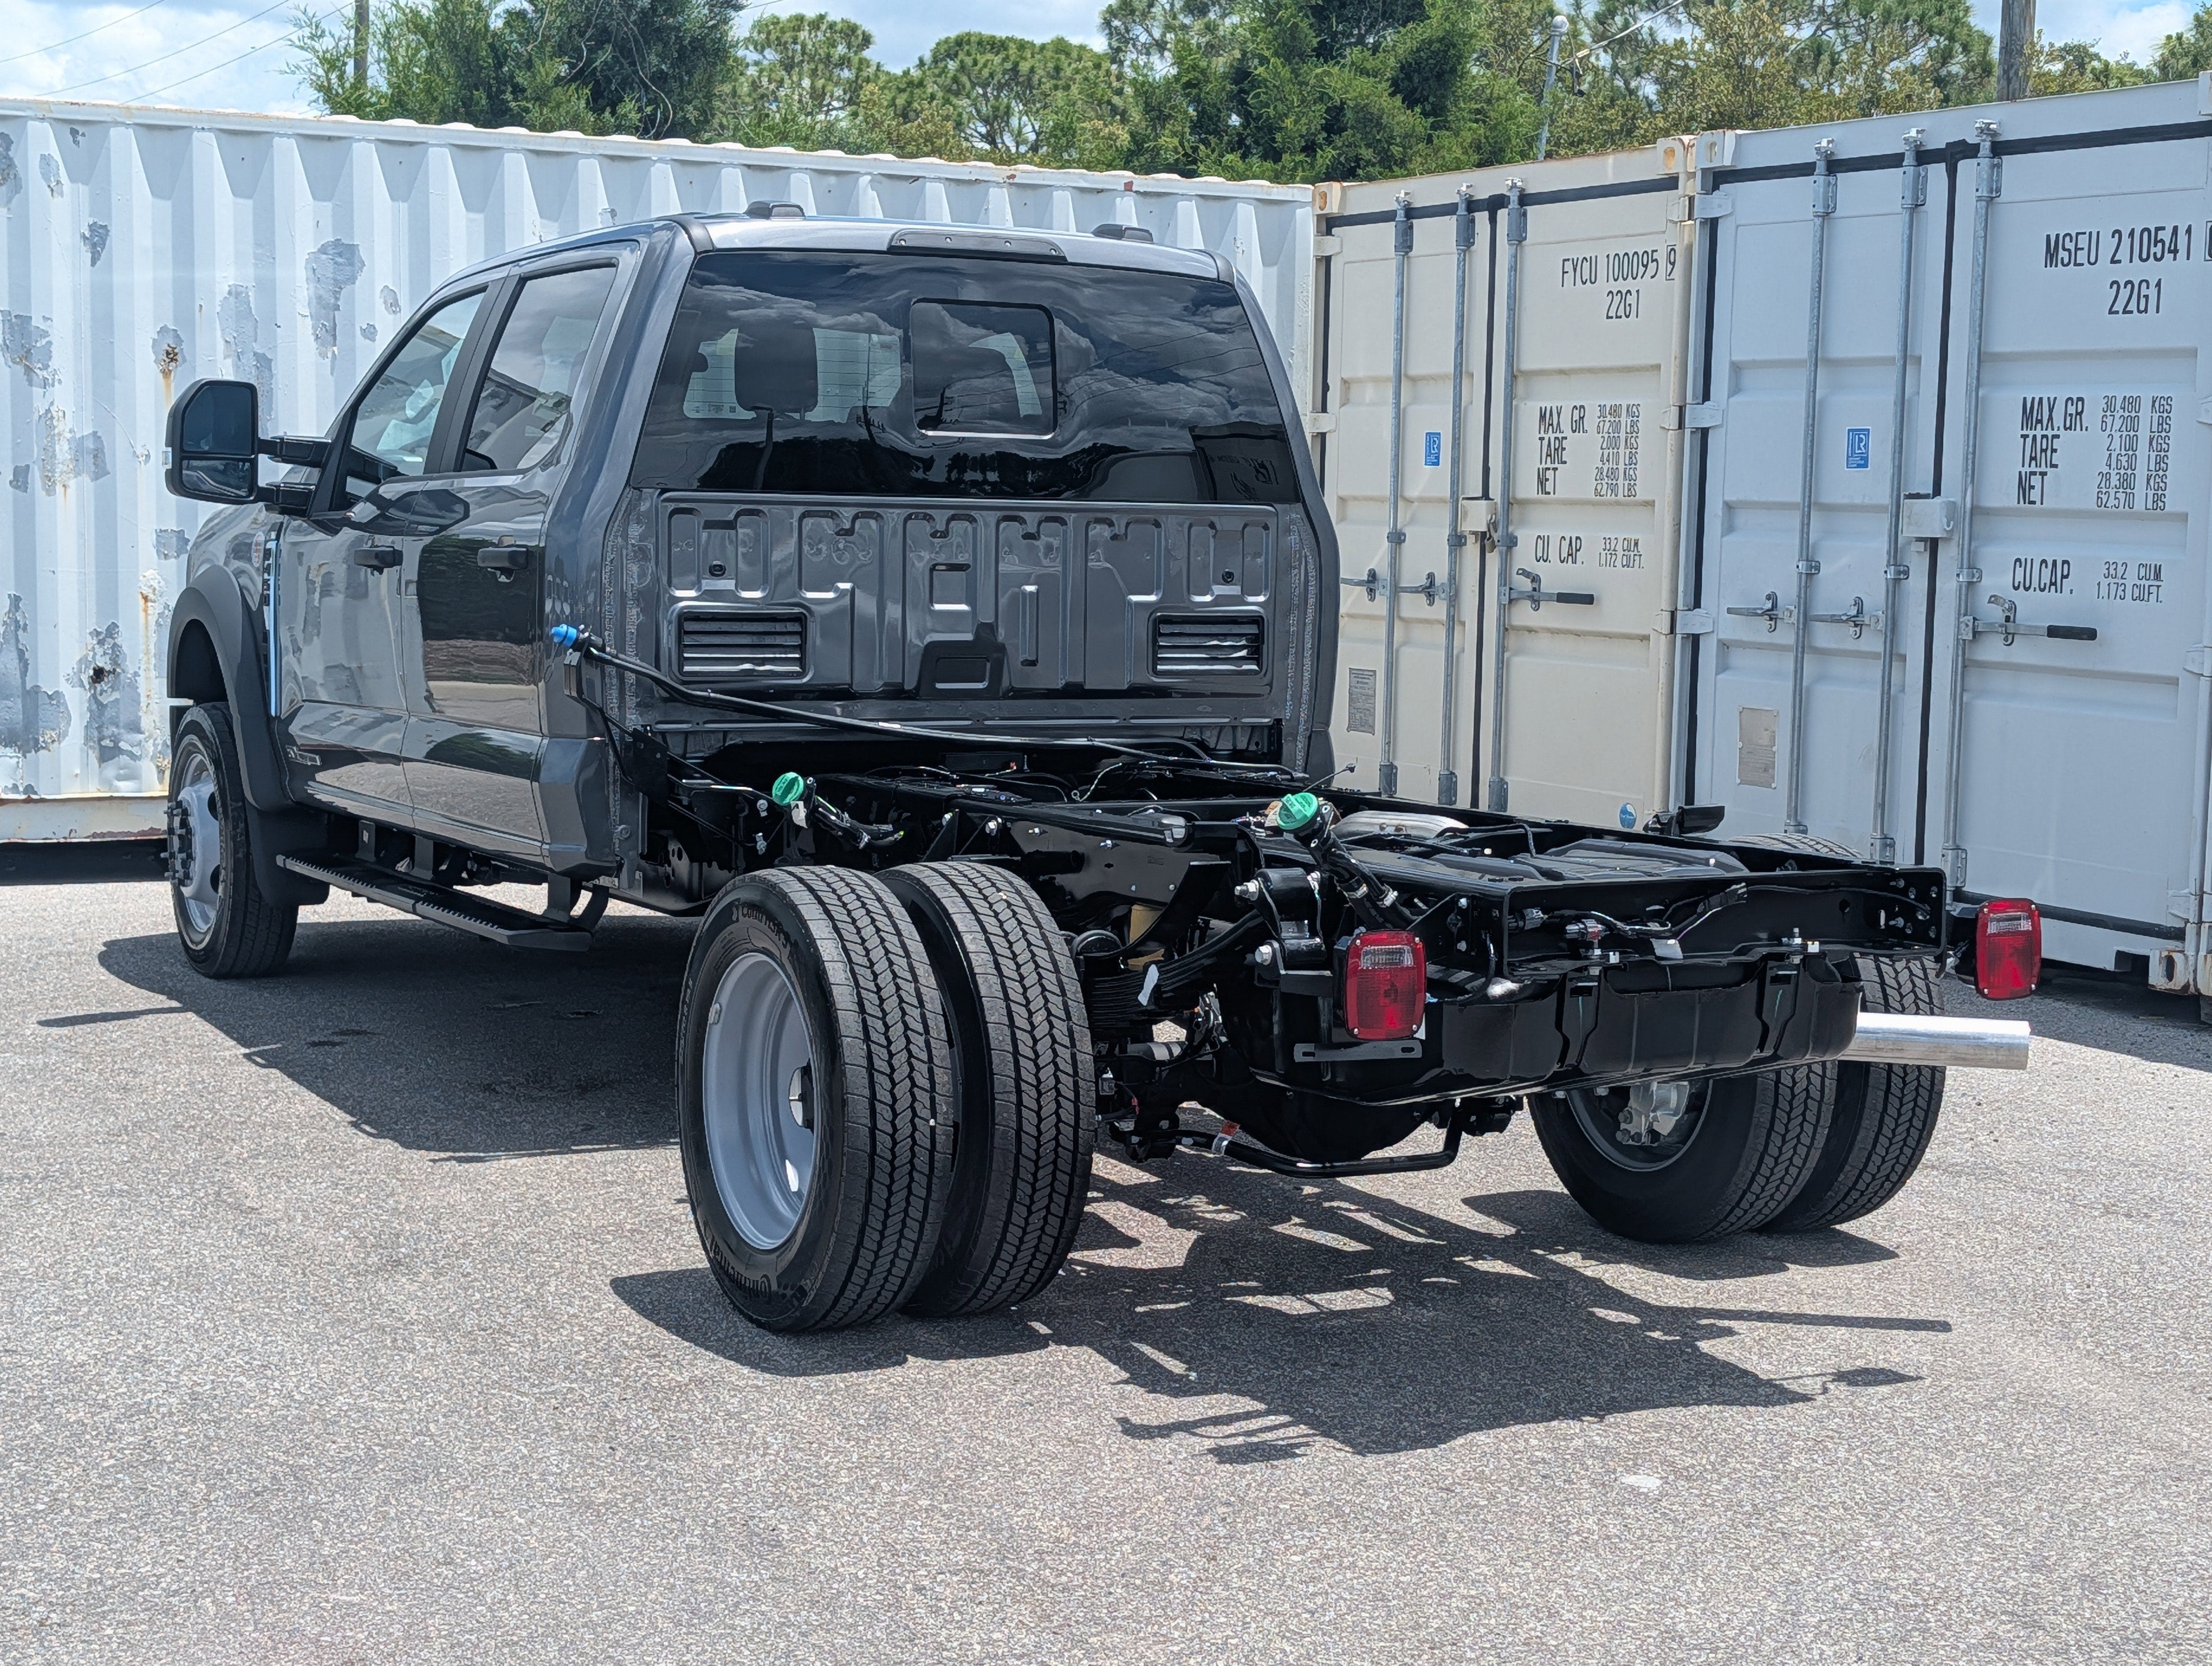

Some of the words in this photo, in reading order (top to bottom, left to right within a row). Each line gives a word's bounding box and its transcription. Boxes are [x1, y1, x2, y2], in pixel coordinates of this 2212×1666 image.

[2044, 230, 2100, 268] MSEU
[2110, 224, 2192, 264] 210541
[1561, 255, 1598, 287] FYCU
[1606, 249, 1659, 283] 100095
[1668, 247, 1676, 277] 9
[1606, 289, 1639, 319] 22G1
[2108, 278, 2162, 315] 22G1
[1625, 403, 1641, 419] KGS
[2151, 395, 2173, 414] KGS
[1571, 405, 1588, 434] GR.
[1625, 419, 1640, 435] LBS
[2150, 415, 2172, 434] LBS
[1538, 436, 1568, 465] TARE
[1624, 435, 1639, 450] KGS
[2020, 434, 2060, 469] TARE
[2148, 434, 2171, 453] KGS
[1623, 451, 1638, 466] LBS
[2147, 453, 2169, 473] LBS
[1536, 467, 1559, 495] NET
[1623, 467, 1638, 482] KGS
[2146, 473, 2168, 492] KGS
[1622, 483, 1637, 498] LBS
[2017, 471, 2048, 505] NET
[2145, 492, 2166, 511] LBS
[1535, 534, 1551, 563] CU.
[1559, 535, 1584, 565] CAP.
